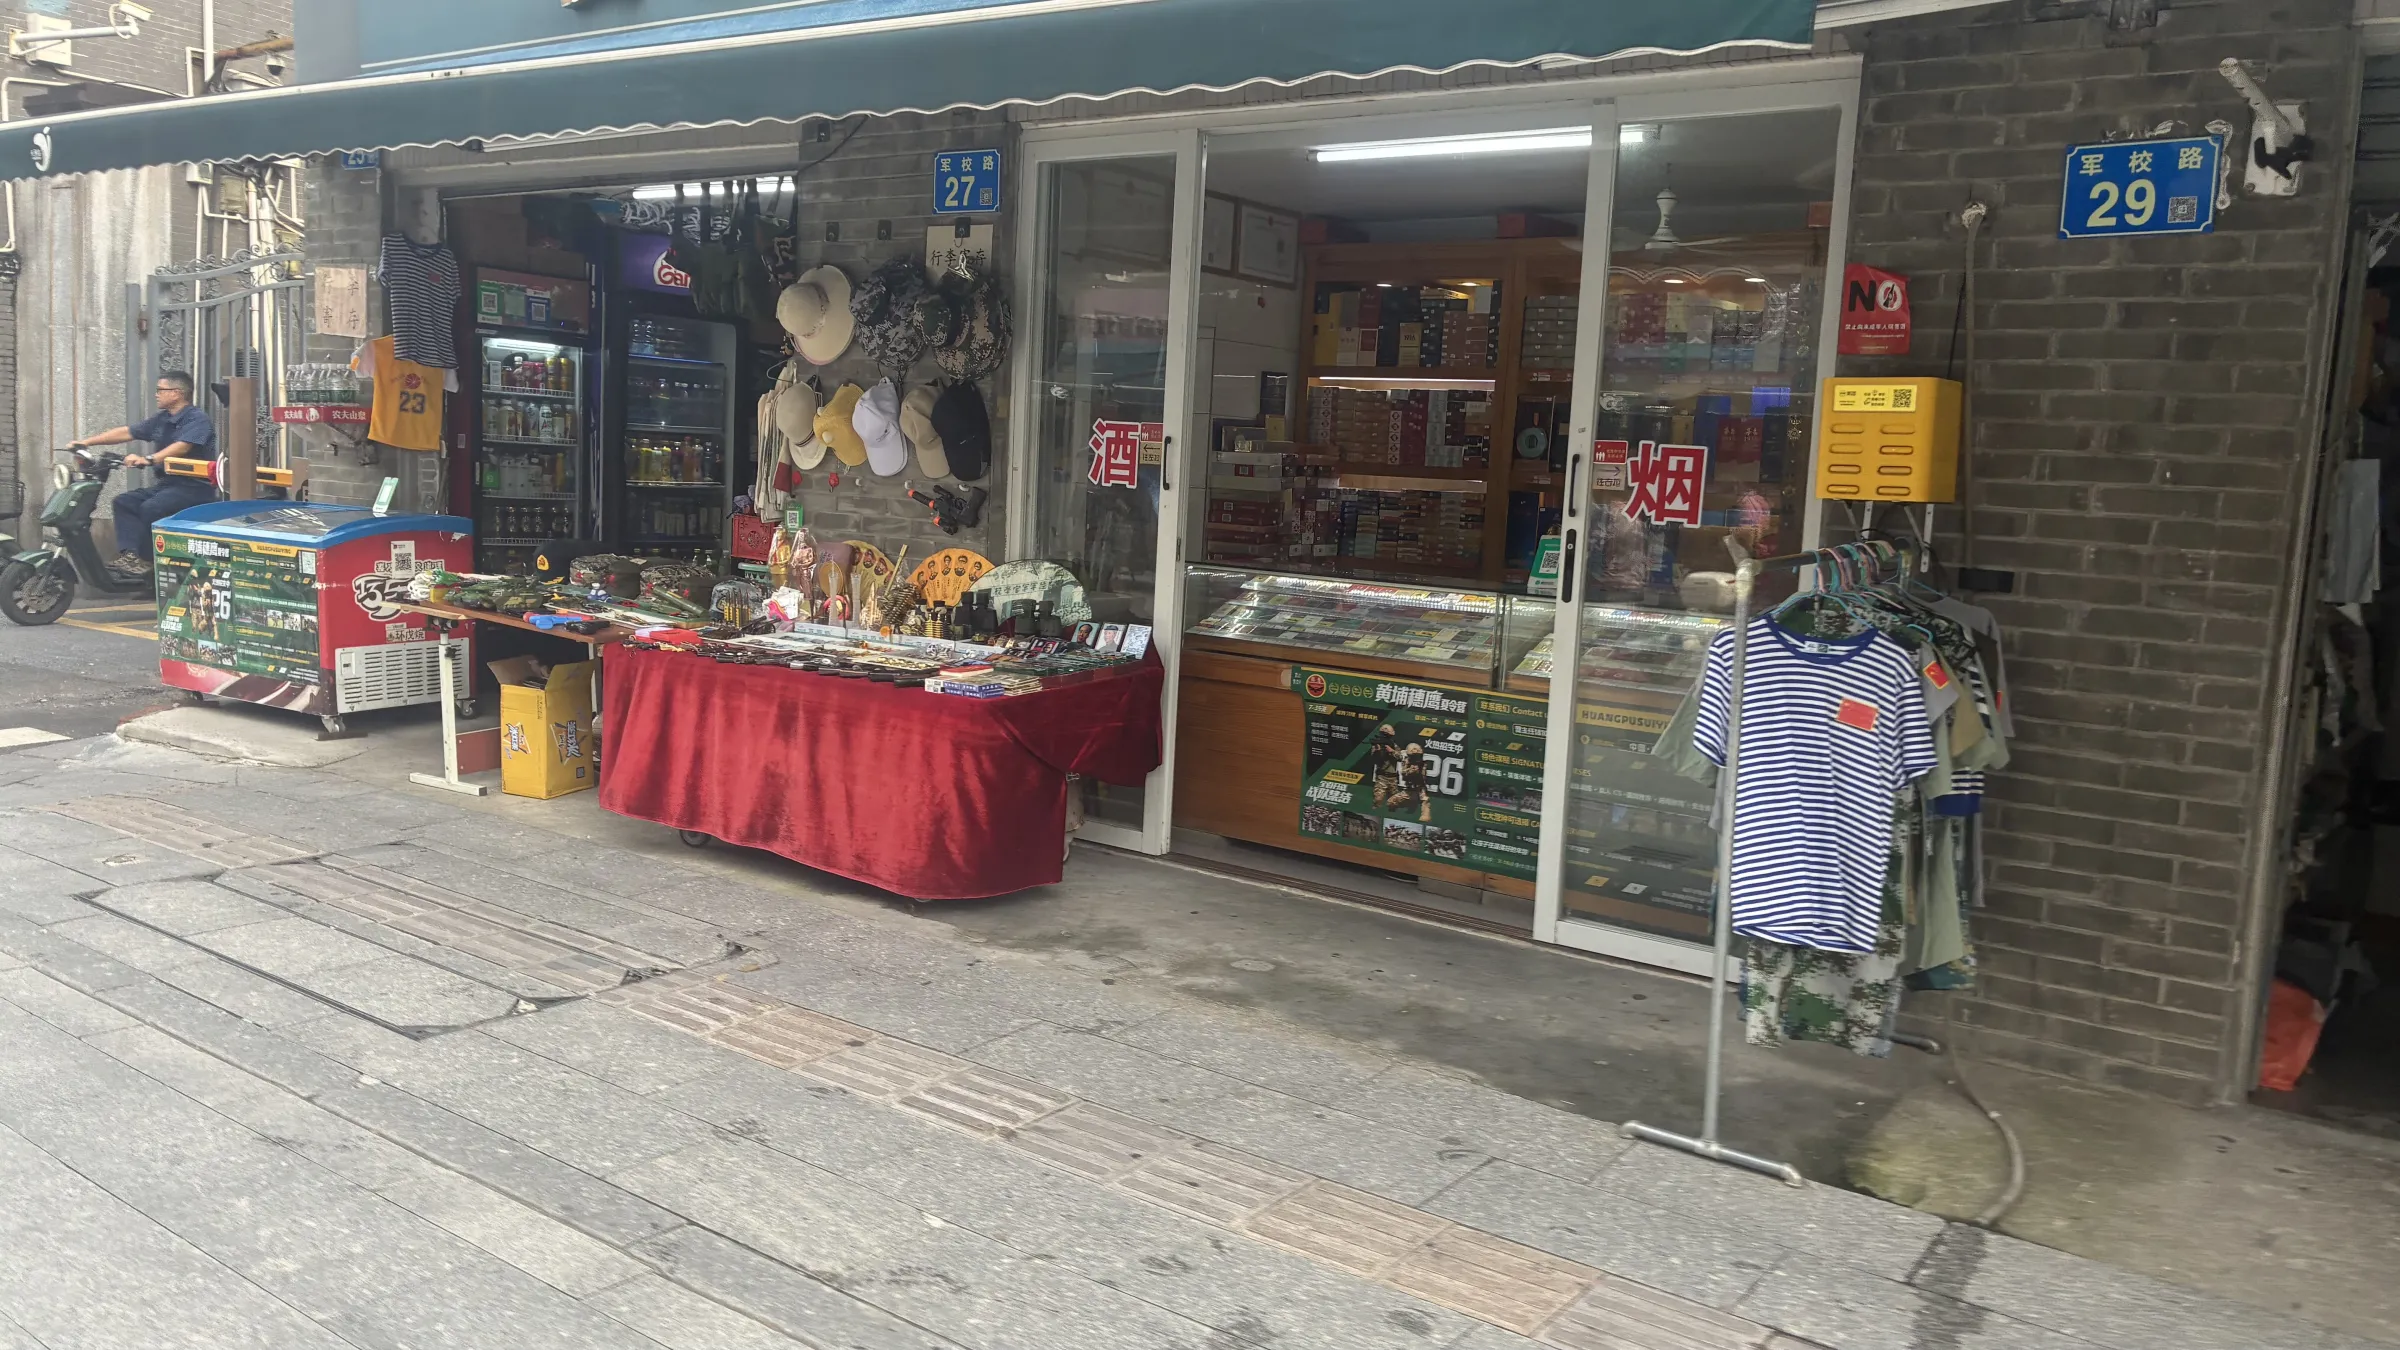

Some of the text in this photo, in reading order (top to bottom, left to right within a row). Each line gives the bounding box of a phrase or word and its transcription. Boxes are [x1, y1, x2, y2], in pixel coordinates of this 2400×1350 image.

[940, 155, 994, 172] 军校路
[2079, 147, 2203, 176] 军校路
[944, 175, 975, 207] 27
[2086, 178, 2156, 228] 29
[332, 410, 366, 421] 农夫山泉
[400, 391, 426, 414] 23
[1088, 418, 1140, 489] 酒
[1622, 440, 1708, 529] 烟
[1512, 706, 1543, 718] Contact
[1581, 709, 1670, 728] HUANGPUSUIYI
